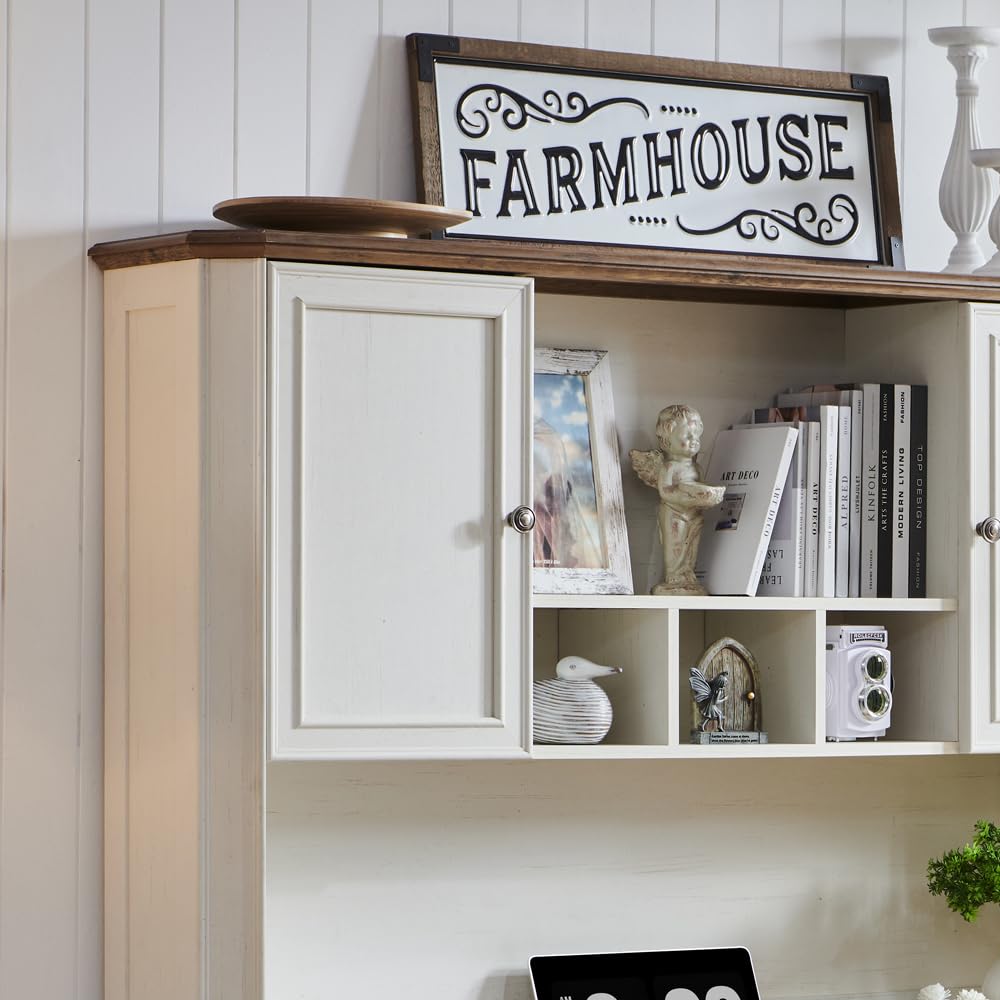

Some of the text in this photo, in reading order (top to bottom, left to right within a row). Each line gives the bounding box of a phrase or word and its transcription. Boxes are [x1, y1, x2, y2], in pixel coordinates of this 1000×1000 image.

[460, 113, 855, 218] FARMHOUSE
[721, 470, 760, 481] ART DECO
[867, 464, 877, 522] KINFOLK
[763, 487, 781, 537] ART DECO
